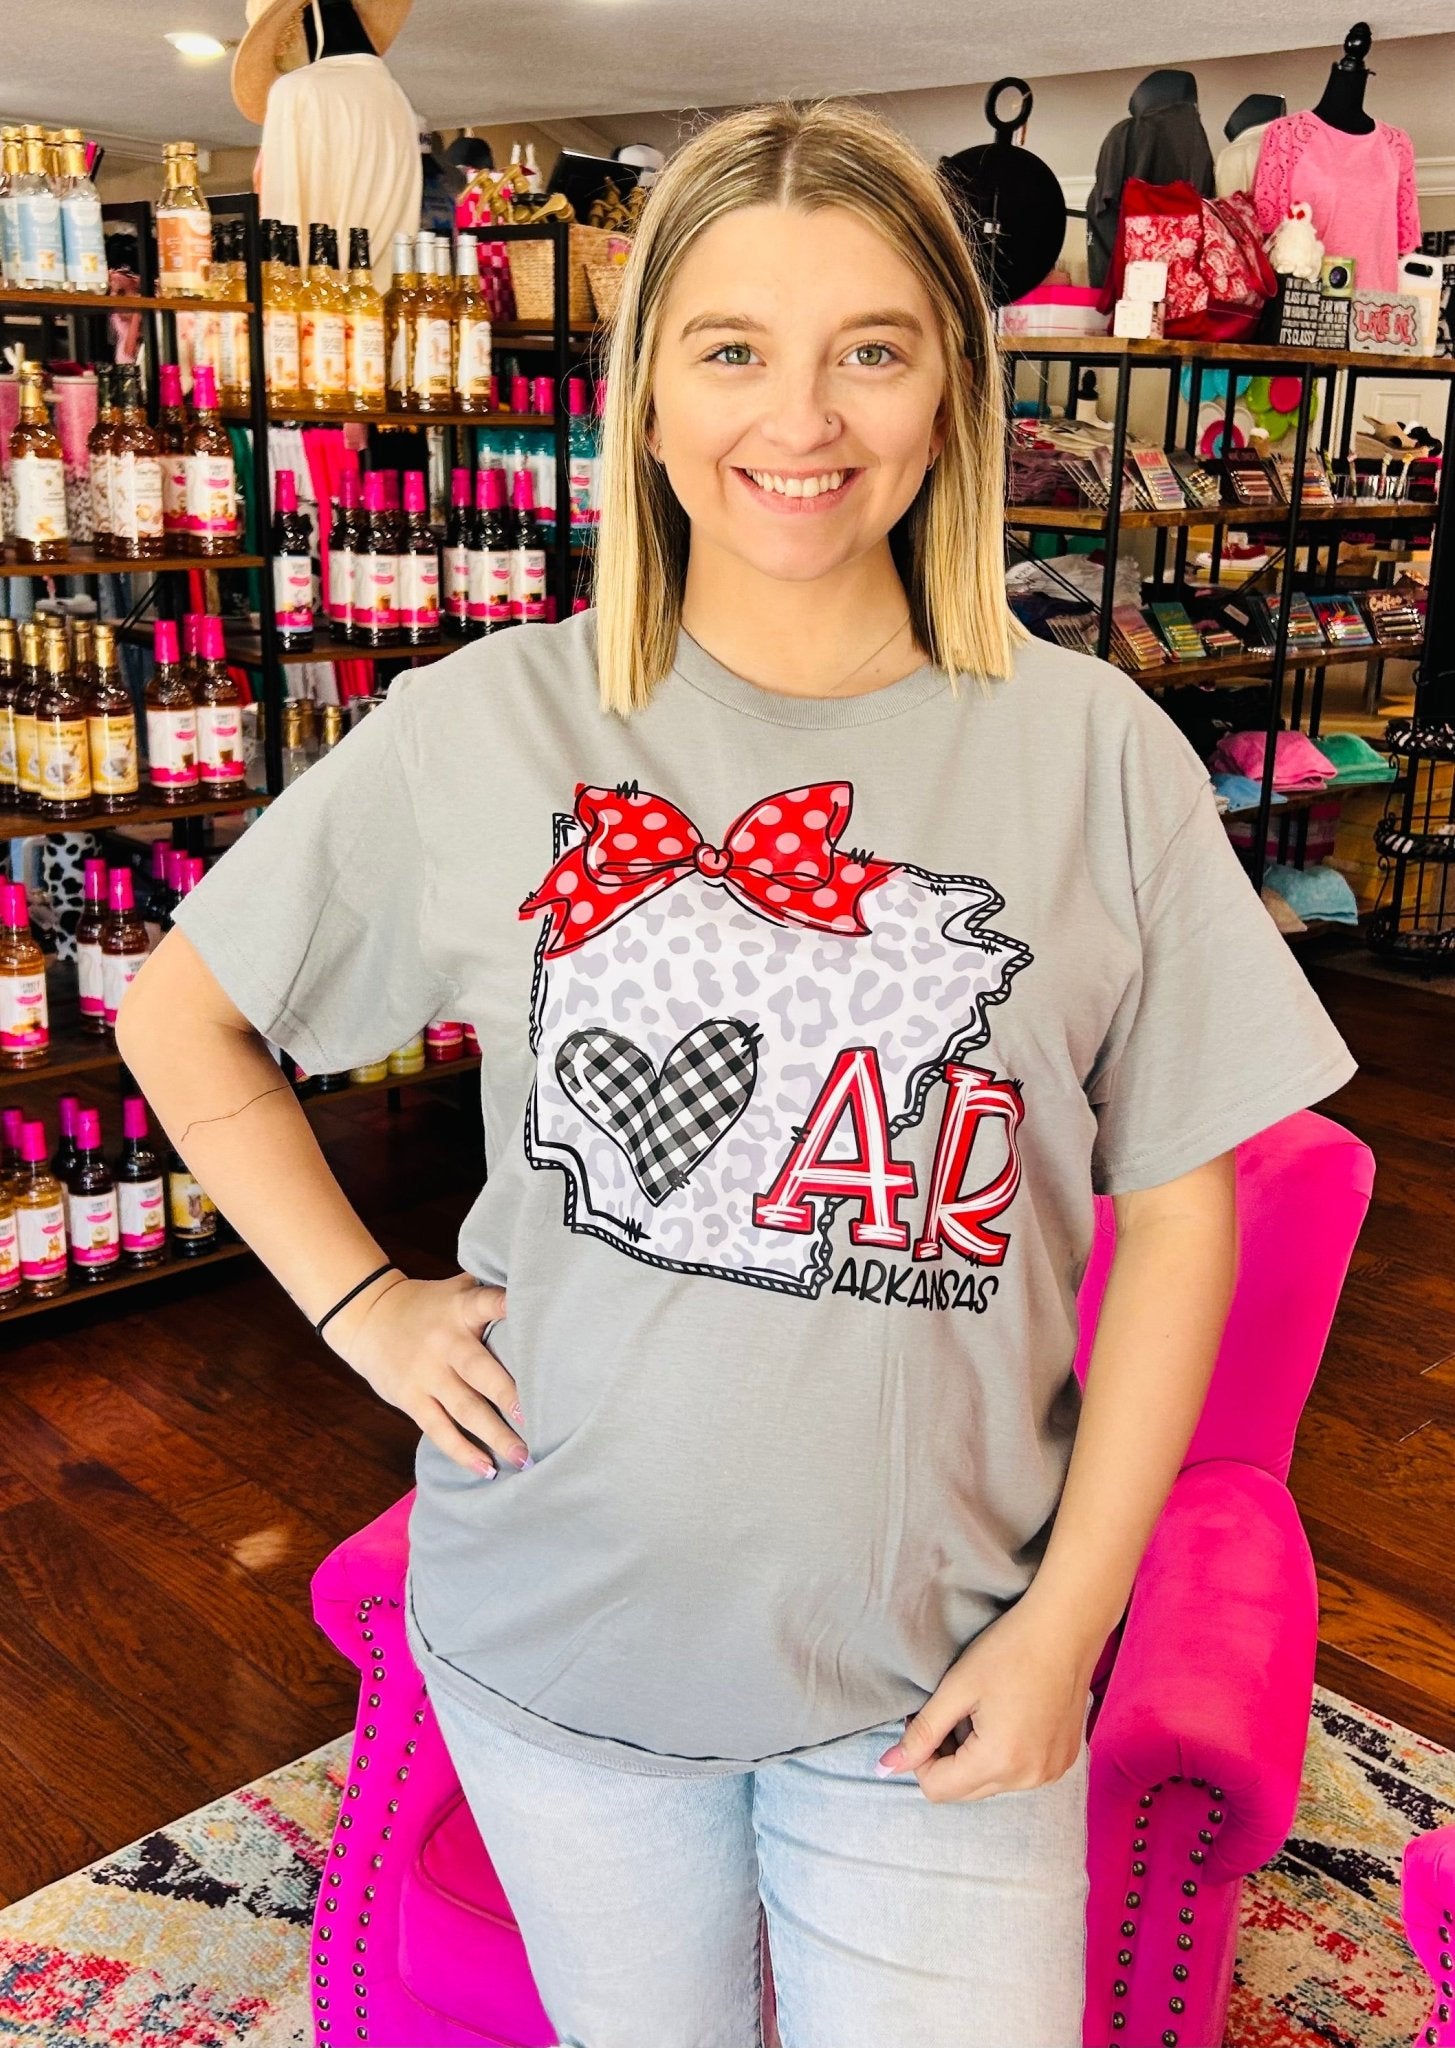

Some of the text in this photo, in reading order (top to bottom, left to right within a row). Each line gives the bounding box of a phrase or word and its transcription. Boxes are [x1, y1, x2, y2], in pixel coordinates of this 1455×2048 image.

[1368, 594, 1402, 612] Coffee
[753, 1046, 1025, 1267] AR
[831, 1257, 999, 1314] ARKANSAS
